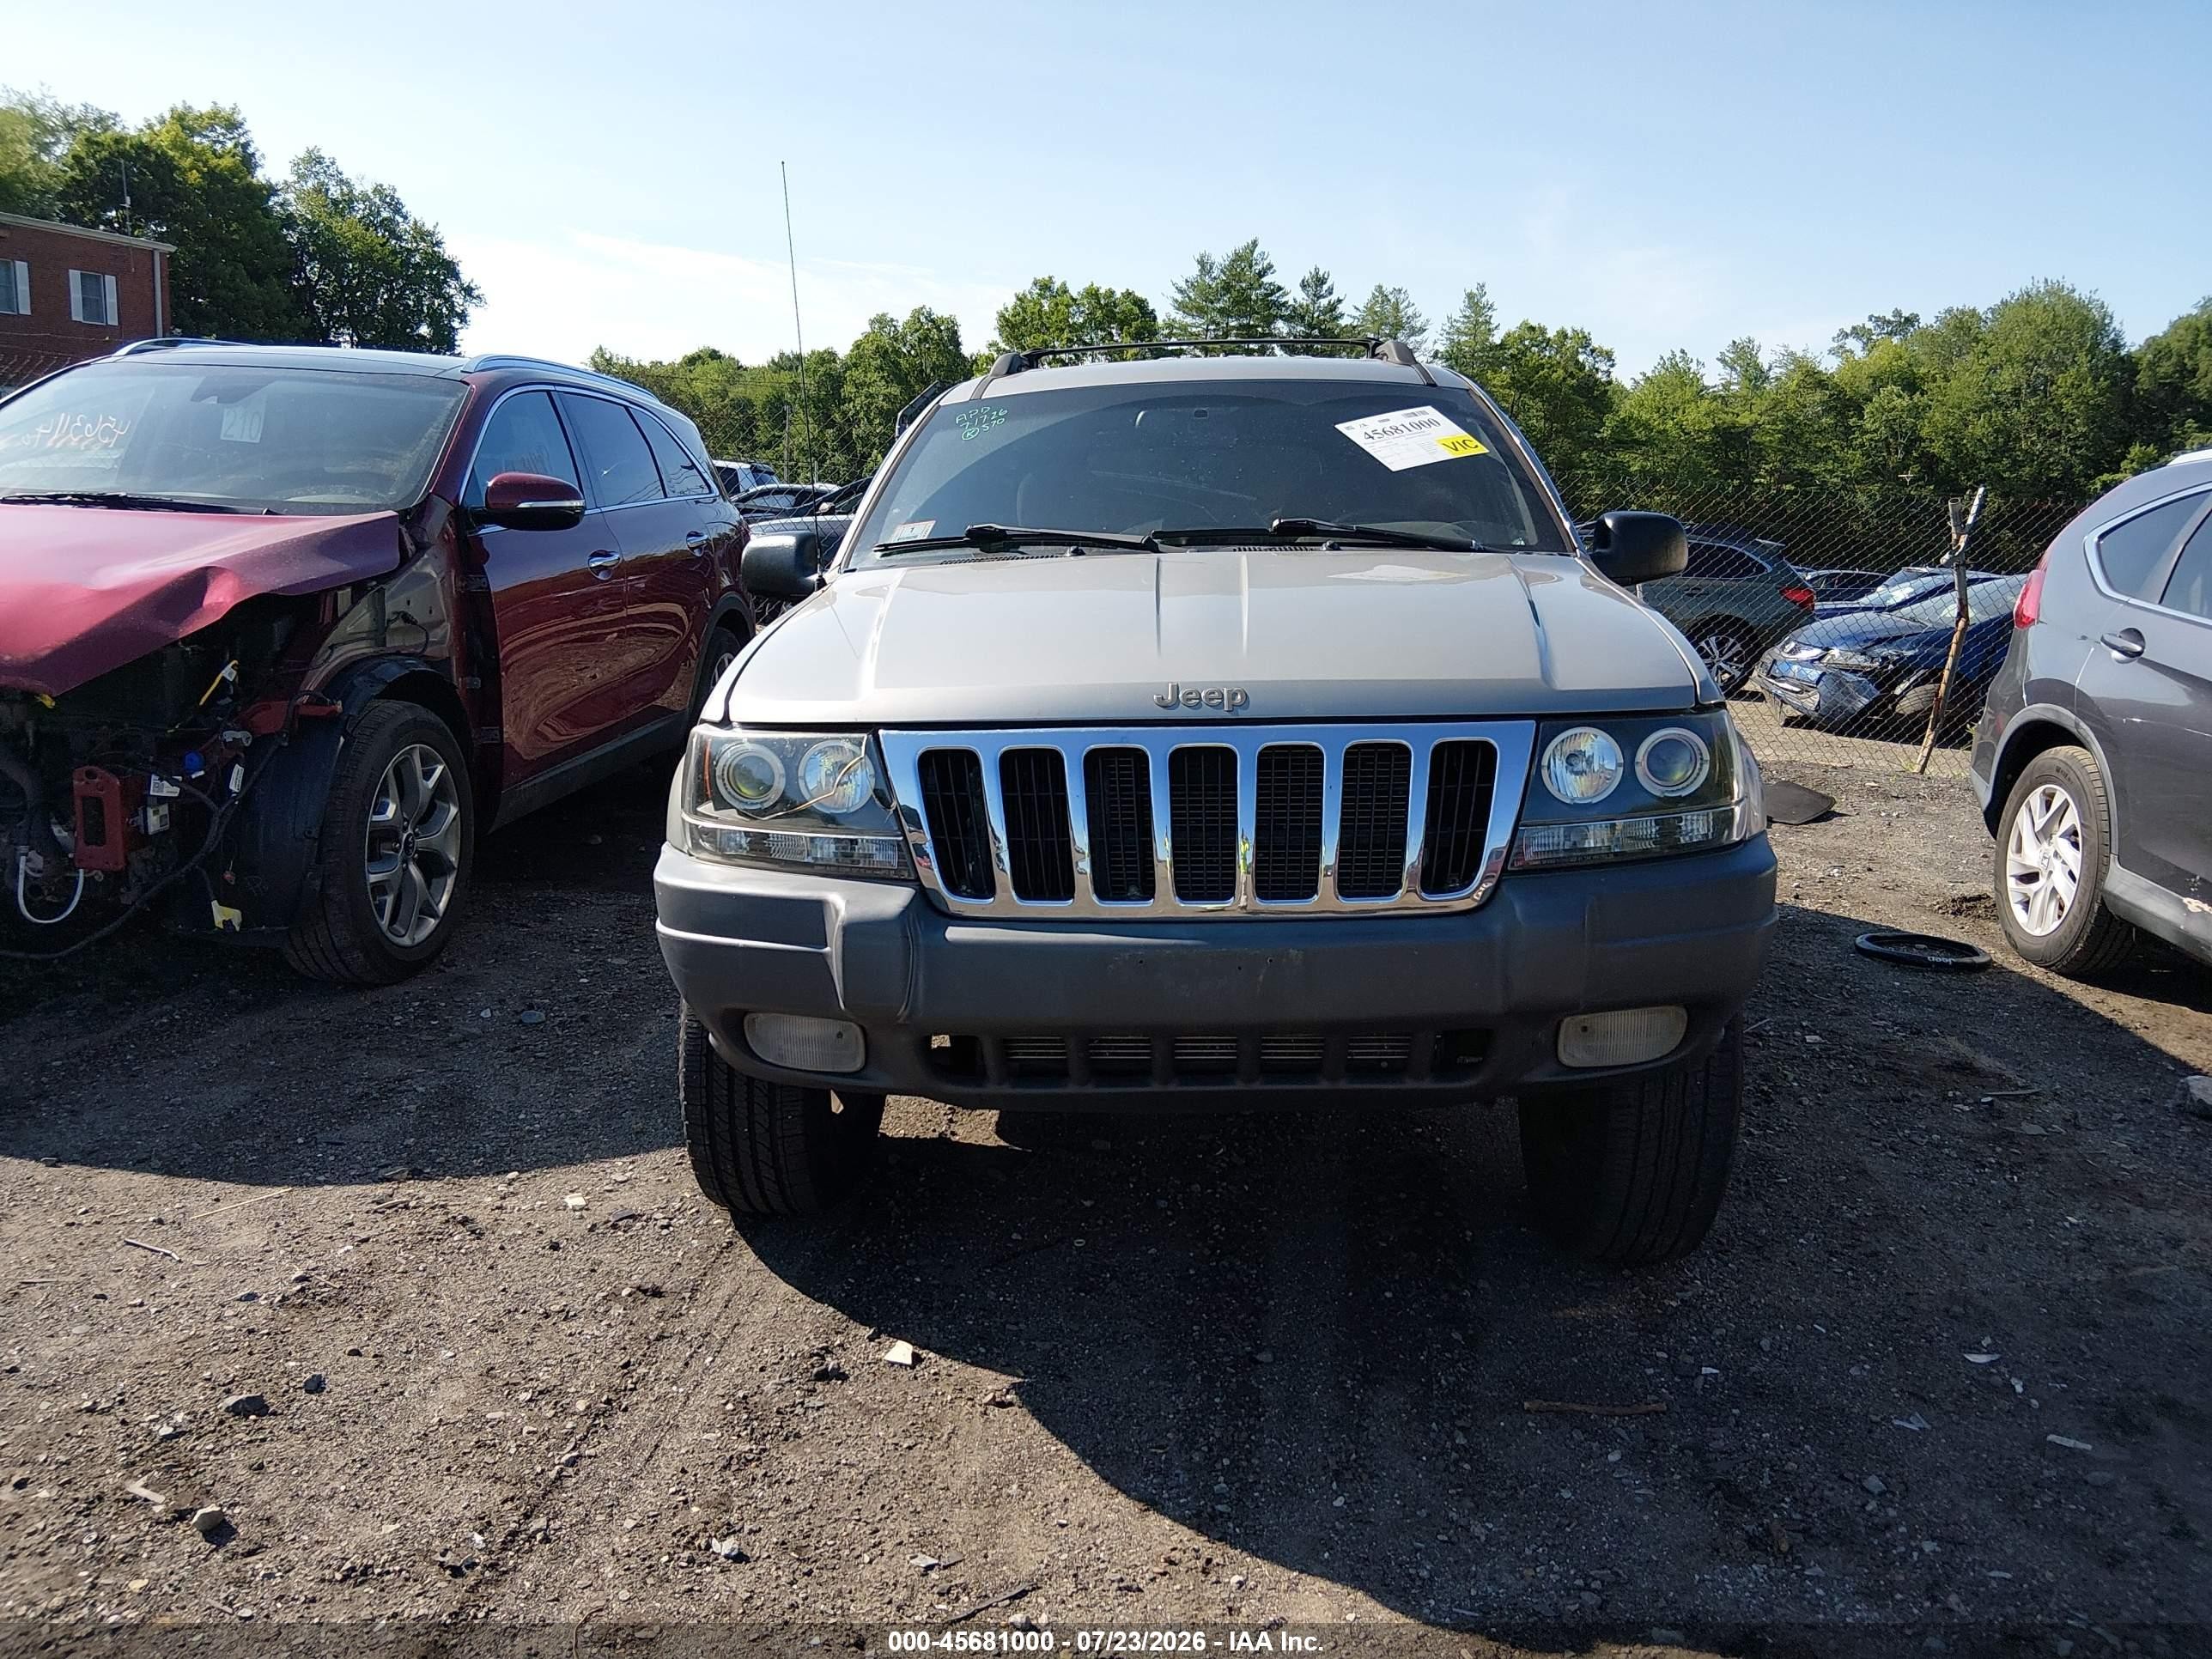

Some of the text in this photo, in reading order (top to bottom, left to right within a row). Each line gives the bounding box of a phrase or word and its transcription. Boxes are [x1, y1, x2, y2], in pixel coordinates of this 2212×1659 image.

[1364, 417, 1441, 441] 45681000
[1442, 439, 1480, 453] VIC
[1153, 682, 1248, 712] Jeep
